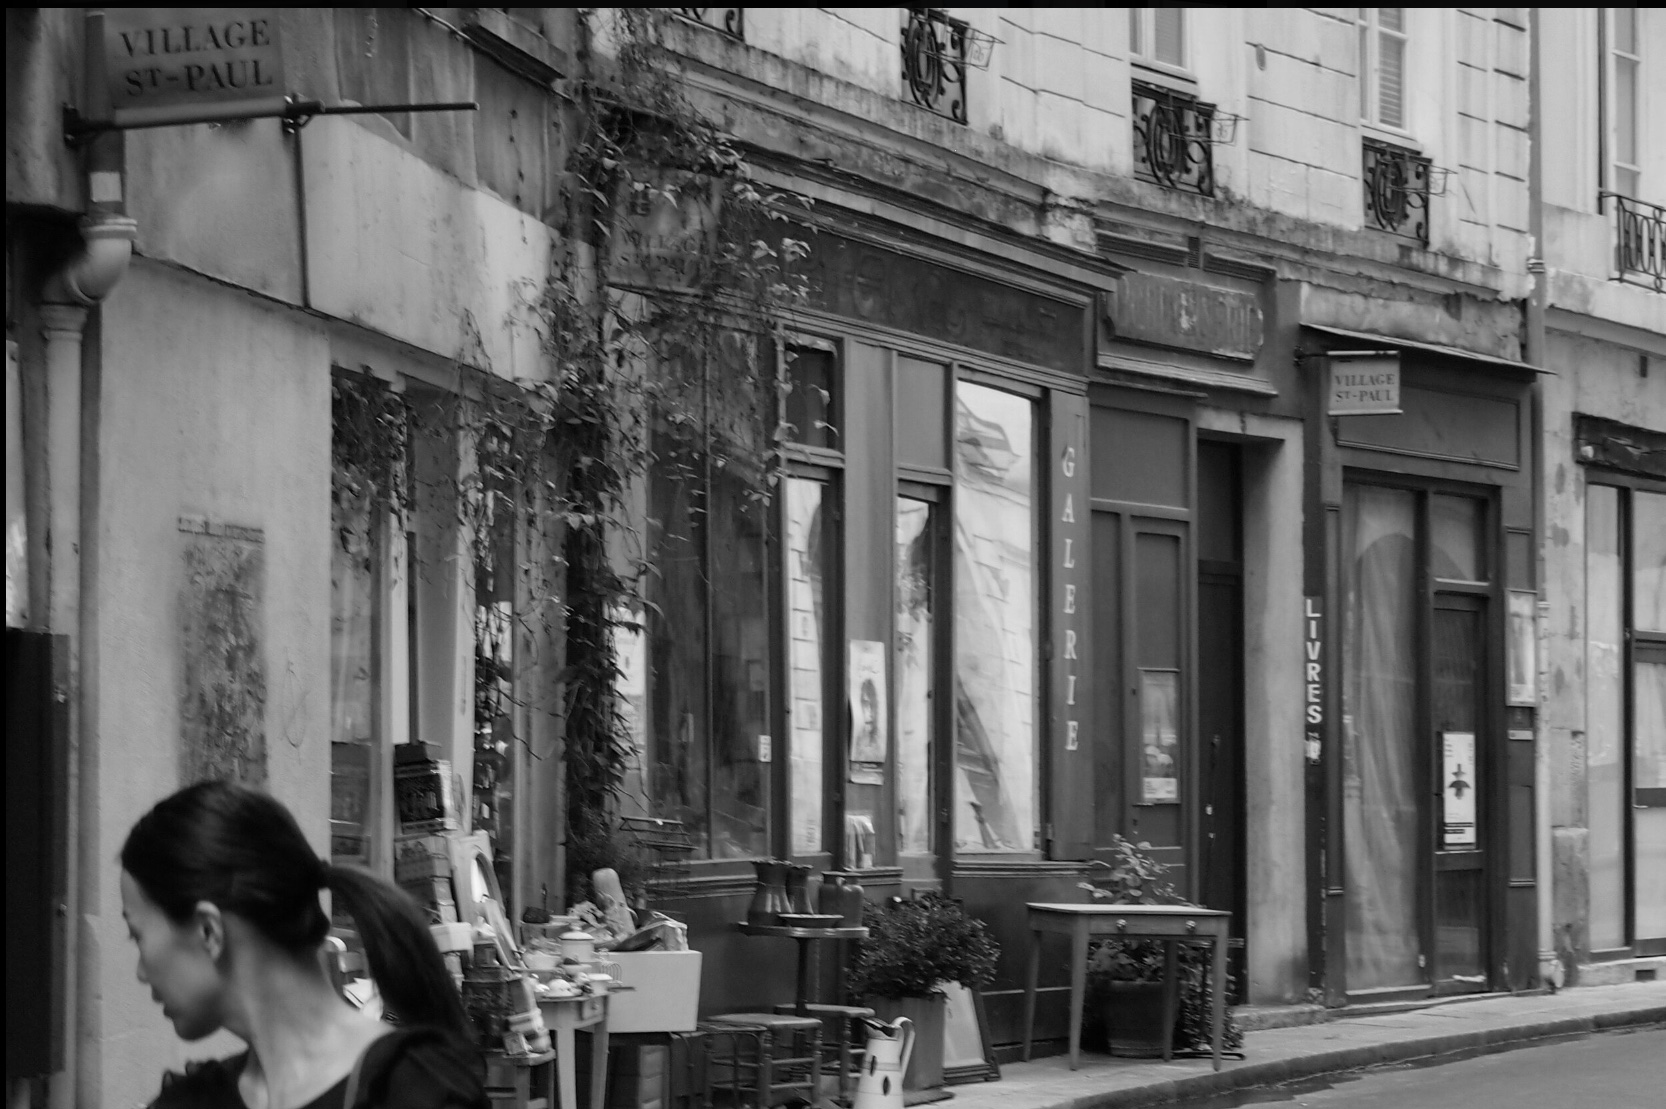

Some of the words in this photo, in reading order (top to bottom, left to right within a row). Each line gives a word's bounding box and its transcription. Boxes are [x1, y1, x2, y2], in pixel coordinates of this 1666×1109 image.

[119, 20, 271, 57] VILLAGE
[125, 59, 273, 97] ST-PAUL
[1335, 373, 1395, 387] VILLAGE
[1336, 390, 1393, 403] ST-PAUL
[1061, 446, 1079, 751] GALERIE
[1305, 598, 1323, 724] LIVRES
